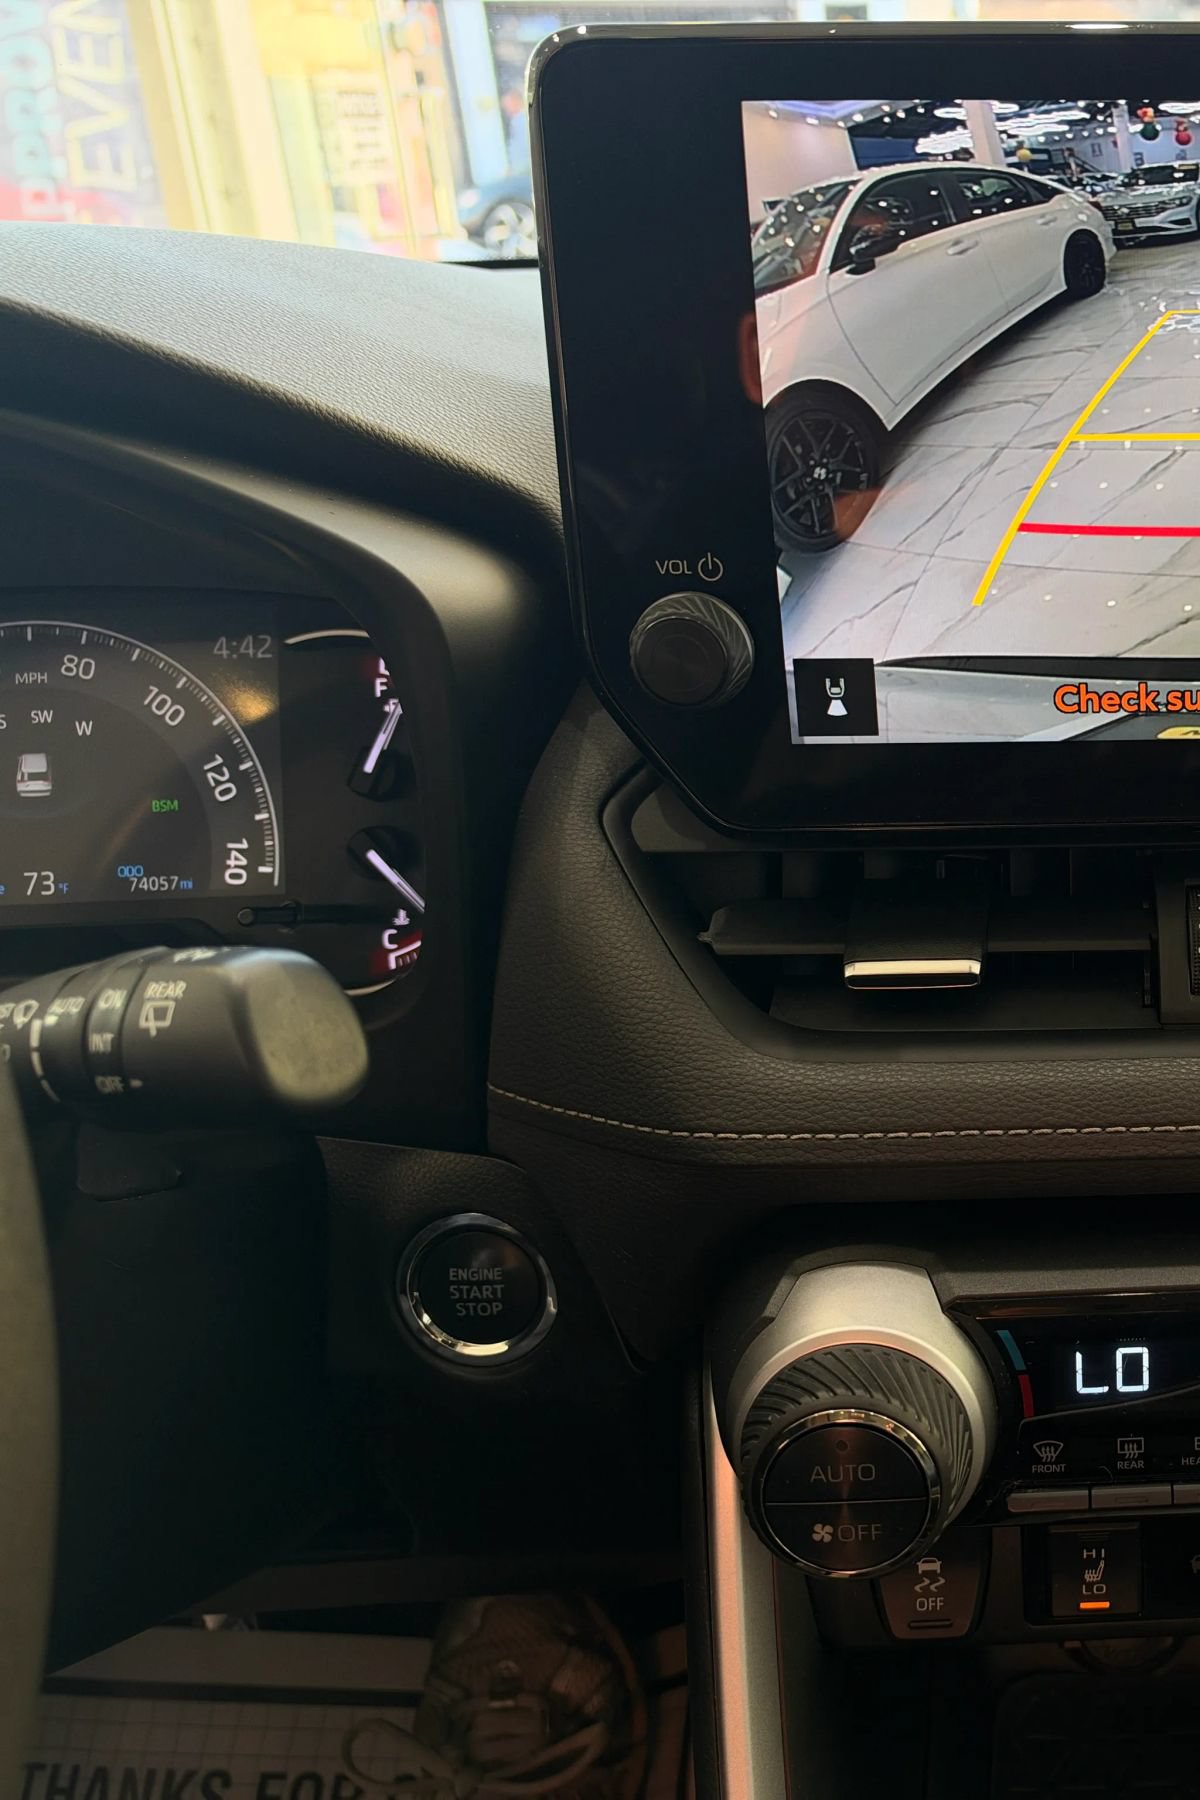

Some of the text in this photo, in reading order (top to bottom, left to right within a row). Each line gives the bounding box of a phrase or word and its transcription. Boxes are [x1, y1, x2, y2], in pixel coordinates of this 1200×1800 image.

[655, 559, 693, 575] VOL
[213, 635, 273, 659] 4:42
[61, 654, 95, 680] 80
[15, 671, 48, 684] MPH
[143, 685, 186, 726] 100
[1053, 682, 1161, 714] Check
[30, 709, 54, 724] SW
[75, 719, 93, 737] W
[203, 753, 238, 802] 120
[152, 800, 179, 813] BSM
[224, 838, 249, 886] 140
[117, 865, 144, 878] ODO
[23, 871, 56, 896] 73
[129, 876, 193, 893] 74057 mi
[382, 928, 398, 950] C
[144, 980, 187, 1000] REAR
[449, 1267, 503, 1281] ENGINE
[449, 1284, 505, 1299] START
[456, 1302, 503, 1316] STOP
[1074, 1345, 1151, 1395] LO
[810, 1463, 876, 1483] AUTO
[1031, 1463, 1066, 1474] FRONT
[1117, 1460, 1145, 1470] REAR
[837, 1523, 883, 1542] OFF
[1083, 1548, 1105, 1559] HI
[1082, 1583, 1106, 1595] LO
[916, 1597, 945, 1611] OFF
